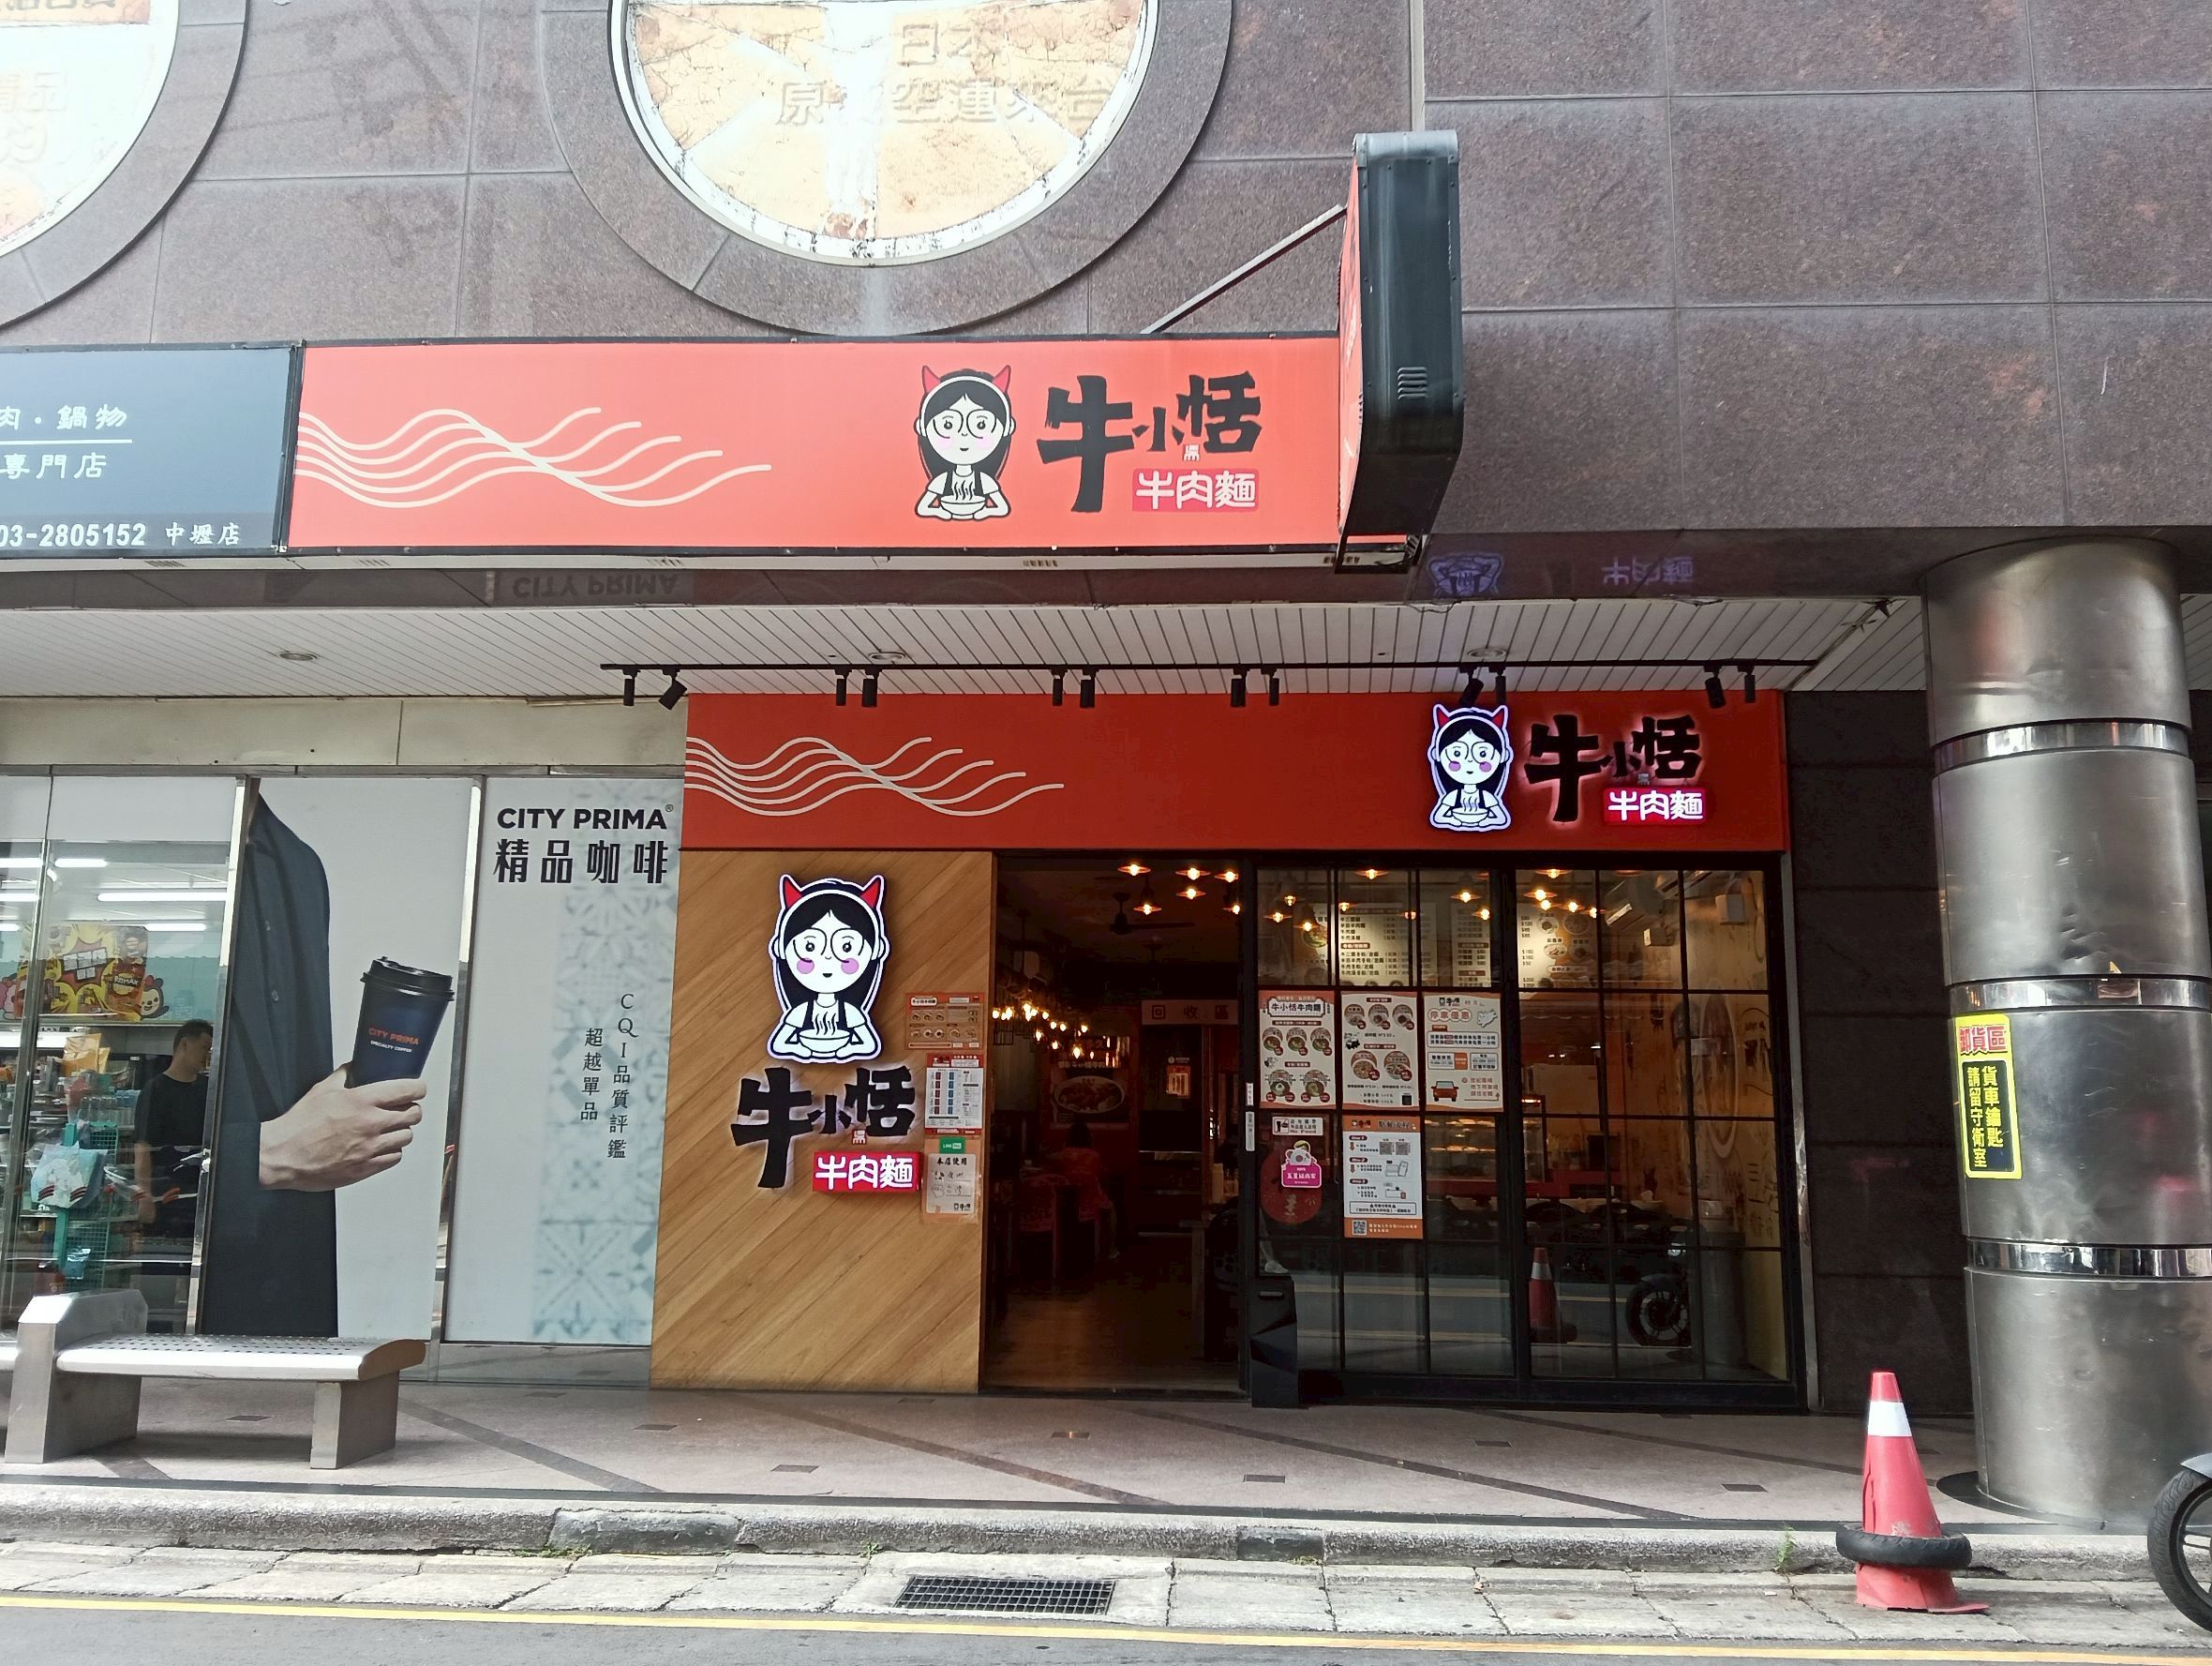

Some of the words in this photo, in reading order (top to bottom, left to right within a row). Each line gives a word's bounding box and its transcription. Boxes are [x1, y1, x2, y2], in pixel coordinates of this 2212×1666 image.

[1036, 370, 1263, 513] 牛小恬
[1, 452, 107, 479] 專門店
[1135, 471, 1257, 509] 牛肉麵
[165, 521, 241, 546] 中壢店
[1524, 713, 1703, 822] 牛小恬
[497, 807, 566, 829] CITY
[1608, 789, 1704, 821] 牛肉麵
[493, 838, 668, 883] 精品咖啡
[580, 1028, 604, 1121] 超越單品
[730, 1065, 916, 1189] 牛小恬
[1981, 1066, 2004, 1148] 貨車鑰匙
[815, 1154, 914, 1191] 牛肉麵
